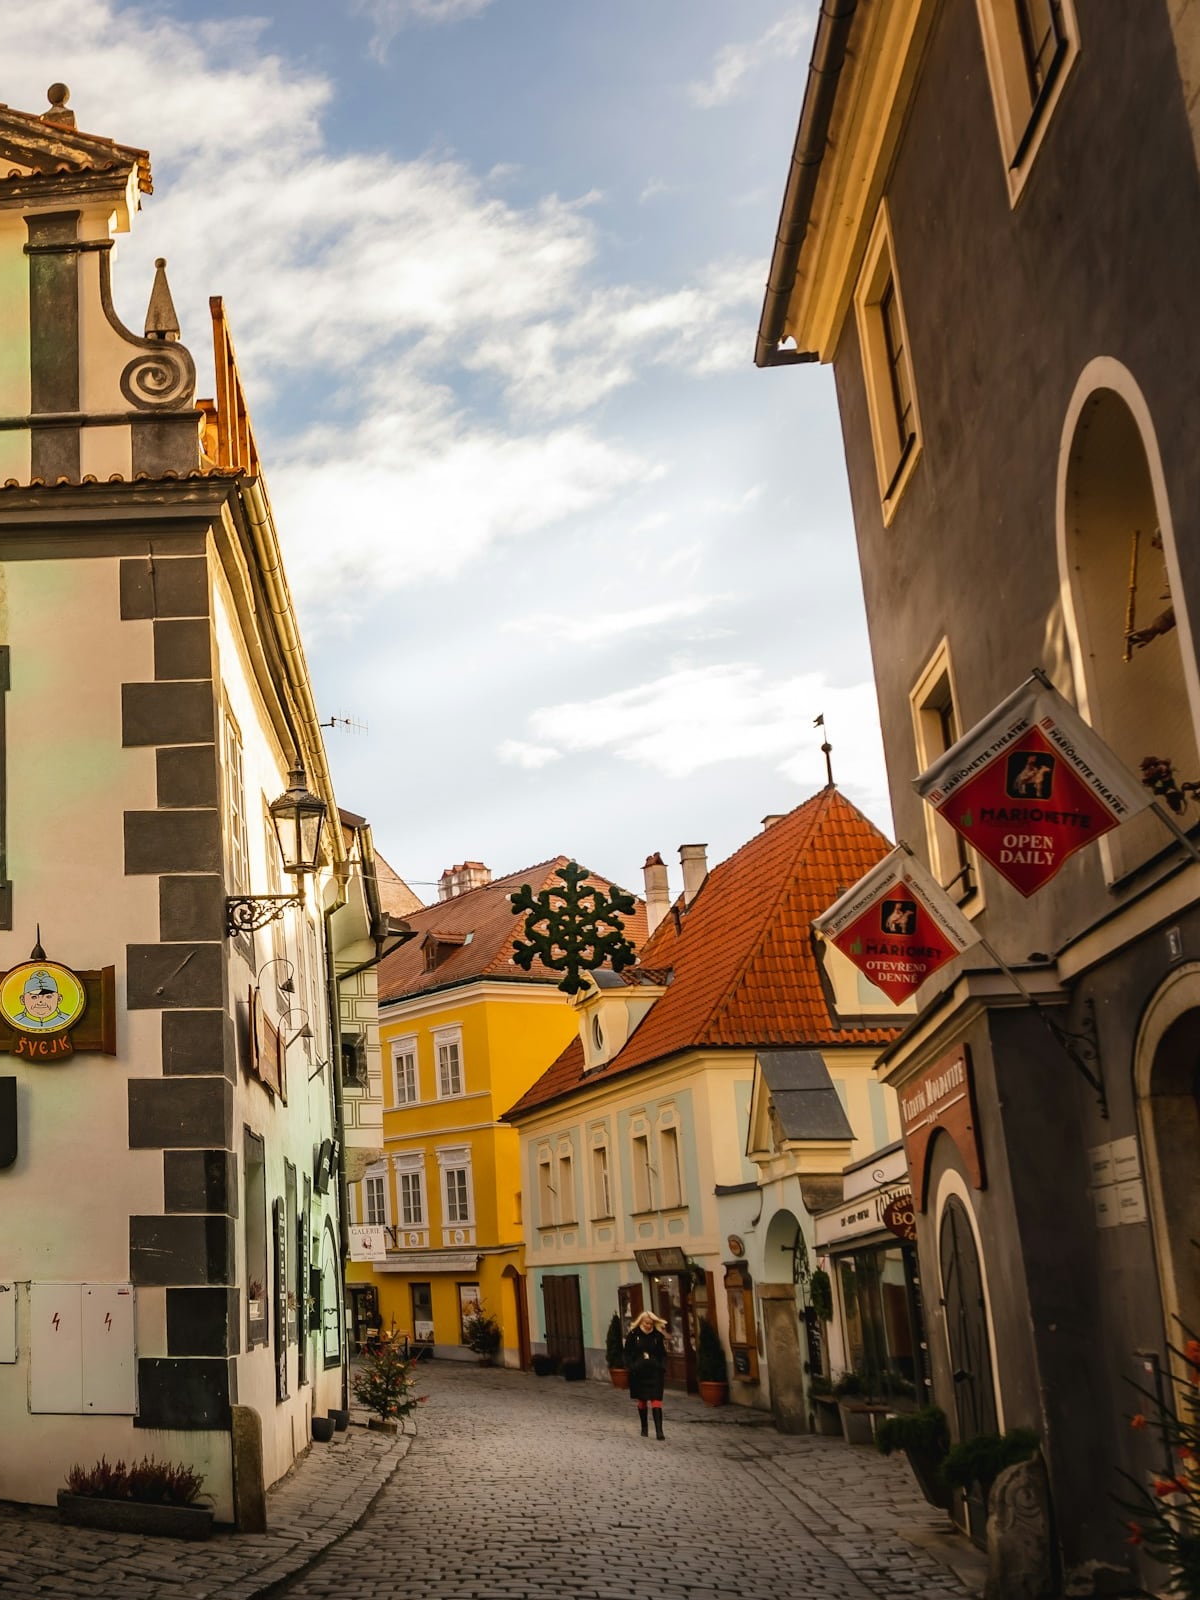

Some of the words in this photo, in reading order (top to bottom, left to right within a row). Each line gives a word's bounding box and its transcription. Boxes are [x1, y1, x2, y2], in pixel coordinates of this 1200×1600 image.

[942, 751, 992, 794] MARIONETTE
[992, 718, 1030, 753] THEATRE
[1048, 729, 1094, 780] MARIONETTE
[1090, 776, 1127, 816] THEATRE
[1002, 833, 1054, 849] OPEN
[999, 850, 1056, 865] DAILY
[866, 960, 927, 972] OTEVŘENO
[15, 1034, 71, 1056] ŠVEJK
[351, 1227, 381, 1235] GALERIE
